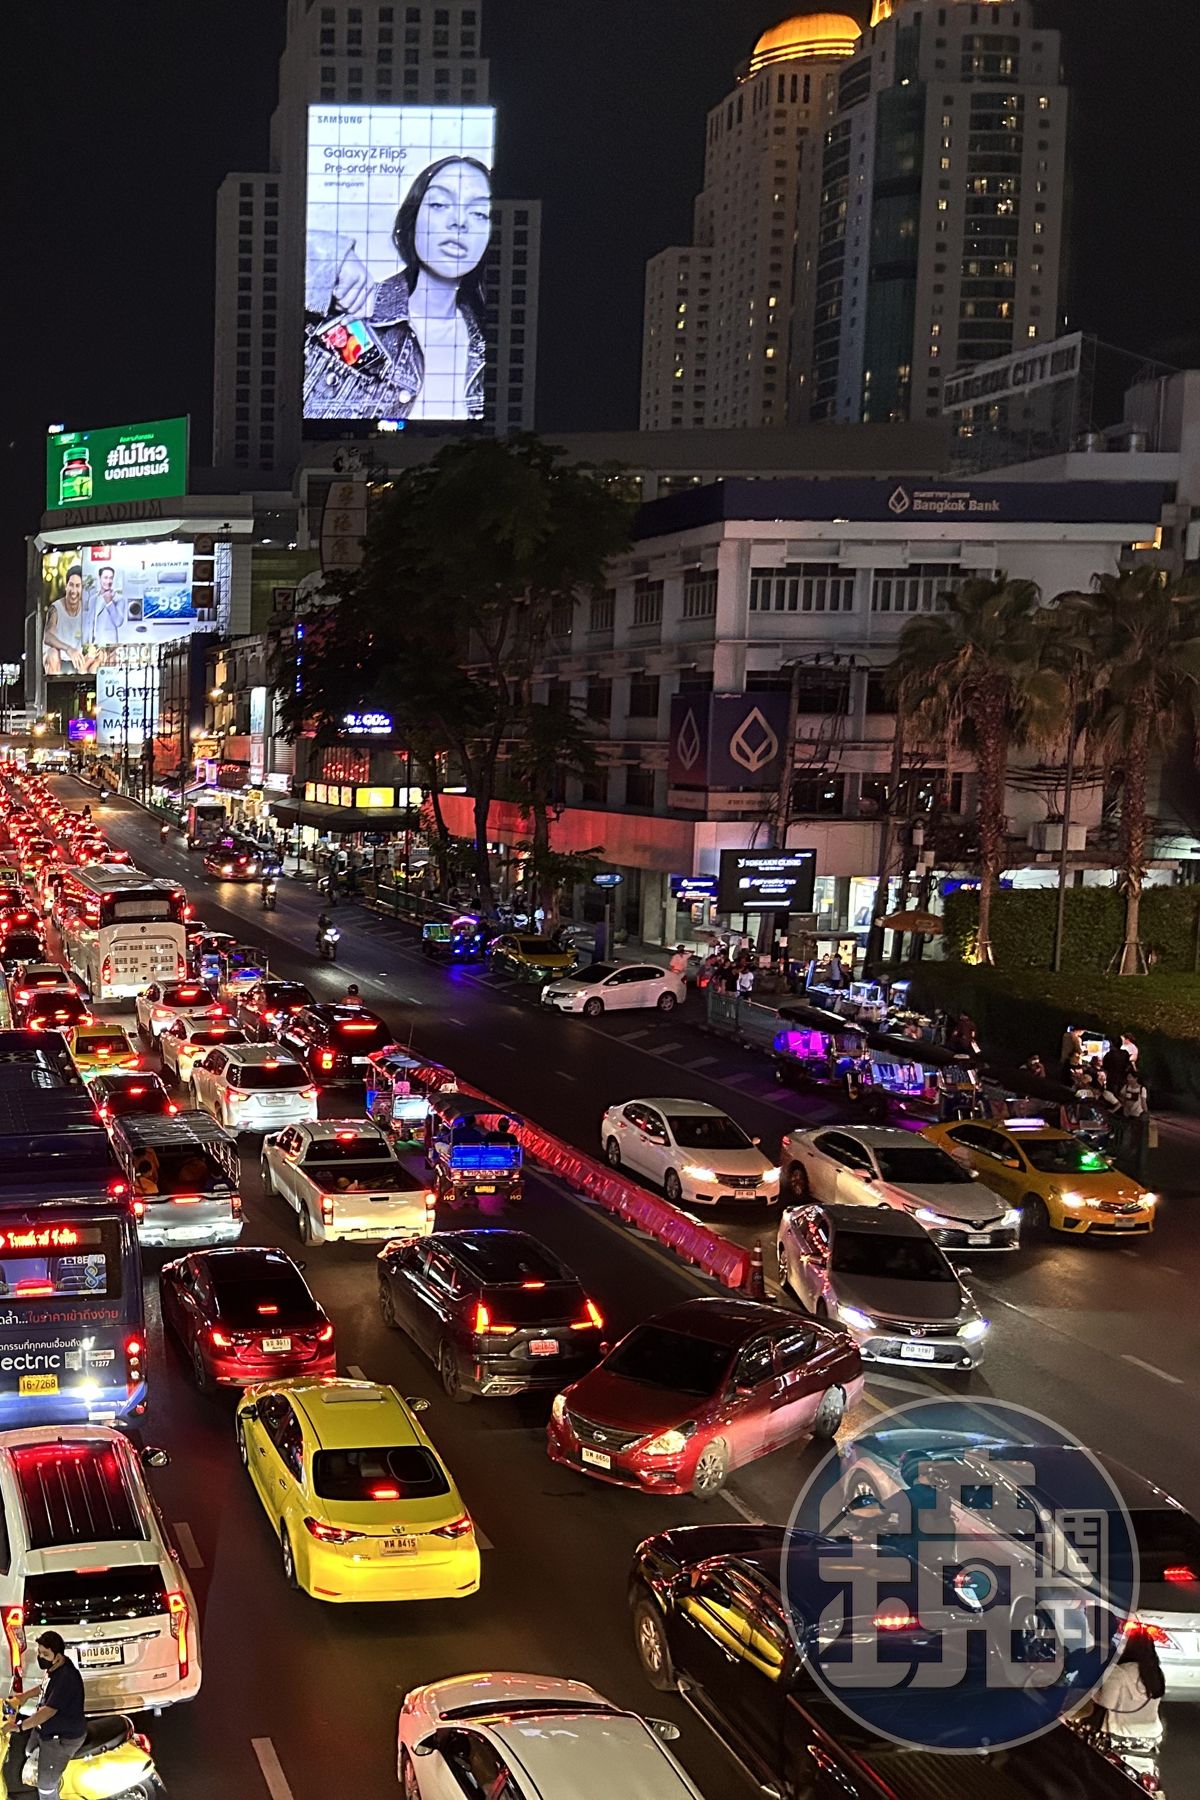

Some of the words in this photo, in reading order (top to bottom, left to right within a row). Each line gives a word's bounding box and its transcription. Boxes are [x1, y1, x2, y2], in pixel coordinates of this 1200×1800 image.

[317, 115, 363, 124] SAMSUNG
[323, 147, 368, 162] Galaxy
[370, 148, 377, 159] Z
[379, 147, 407, 162] Flip5
[324, 163, 377, 174] Pre-order
[379, 164, 405, 174] Now
[106, 442, 168, 467] #ไม่ไหว
[104, 458, 170, 480] บอกแบรนด์
[63, 500, 162, 526] PALLADIUM
[912, 499, 966, 513] Bangkok
[968, 499, 1000, 511] Bank
[22, 1378, 56, 1391] 16-7268
[99, 1645, 120, 1656] 8879
